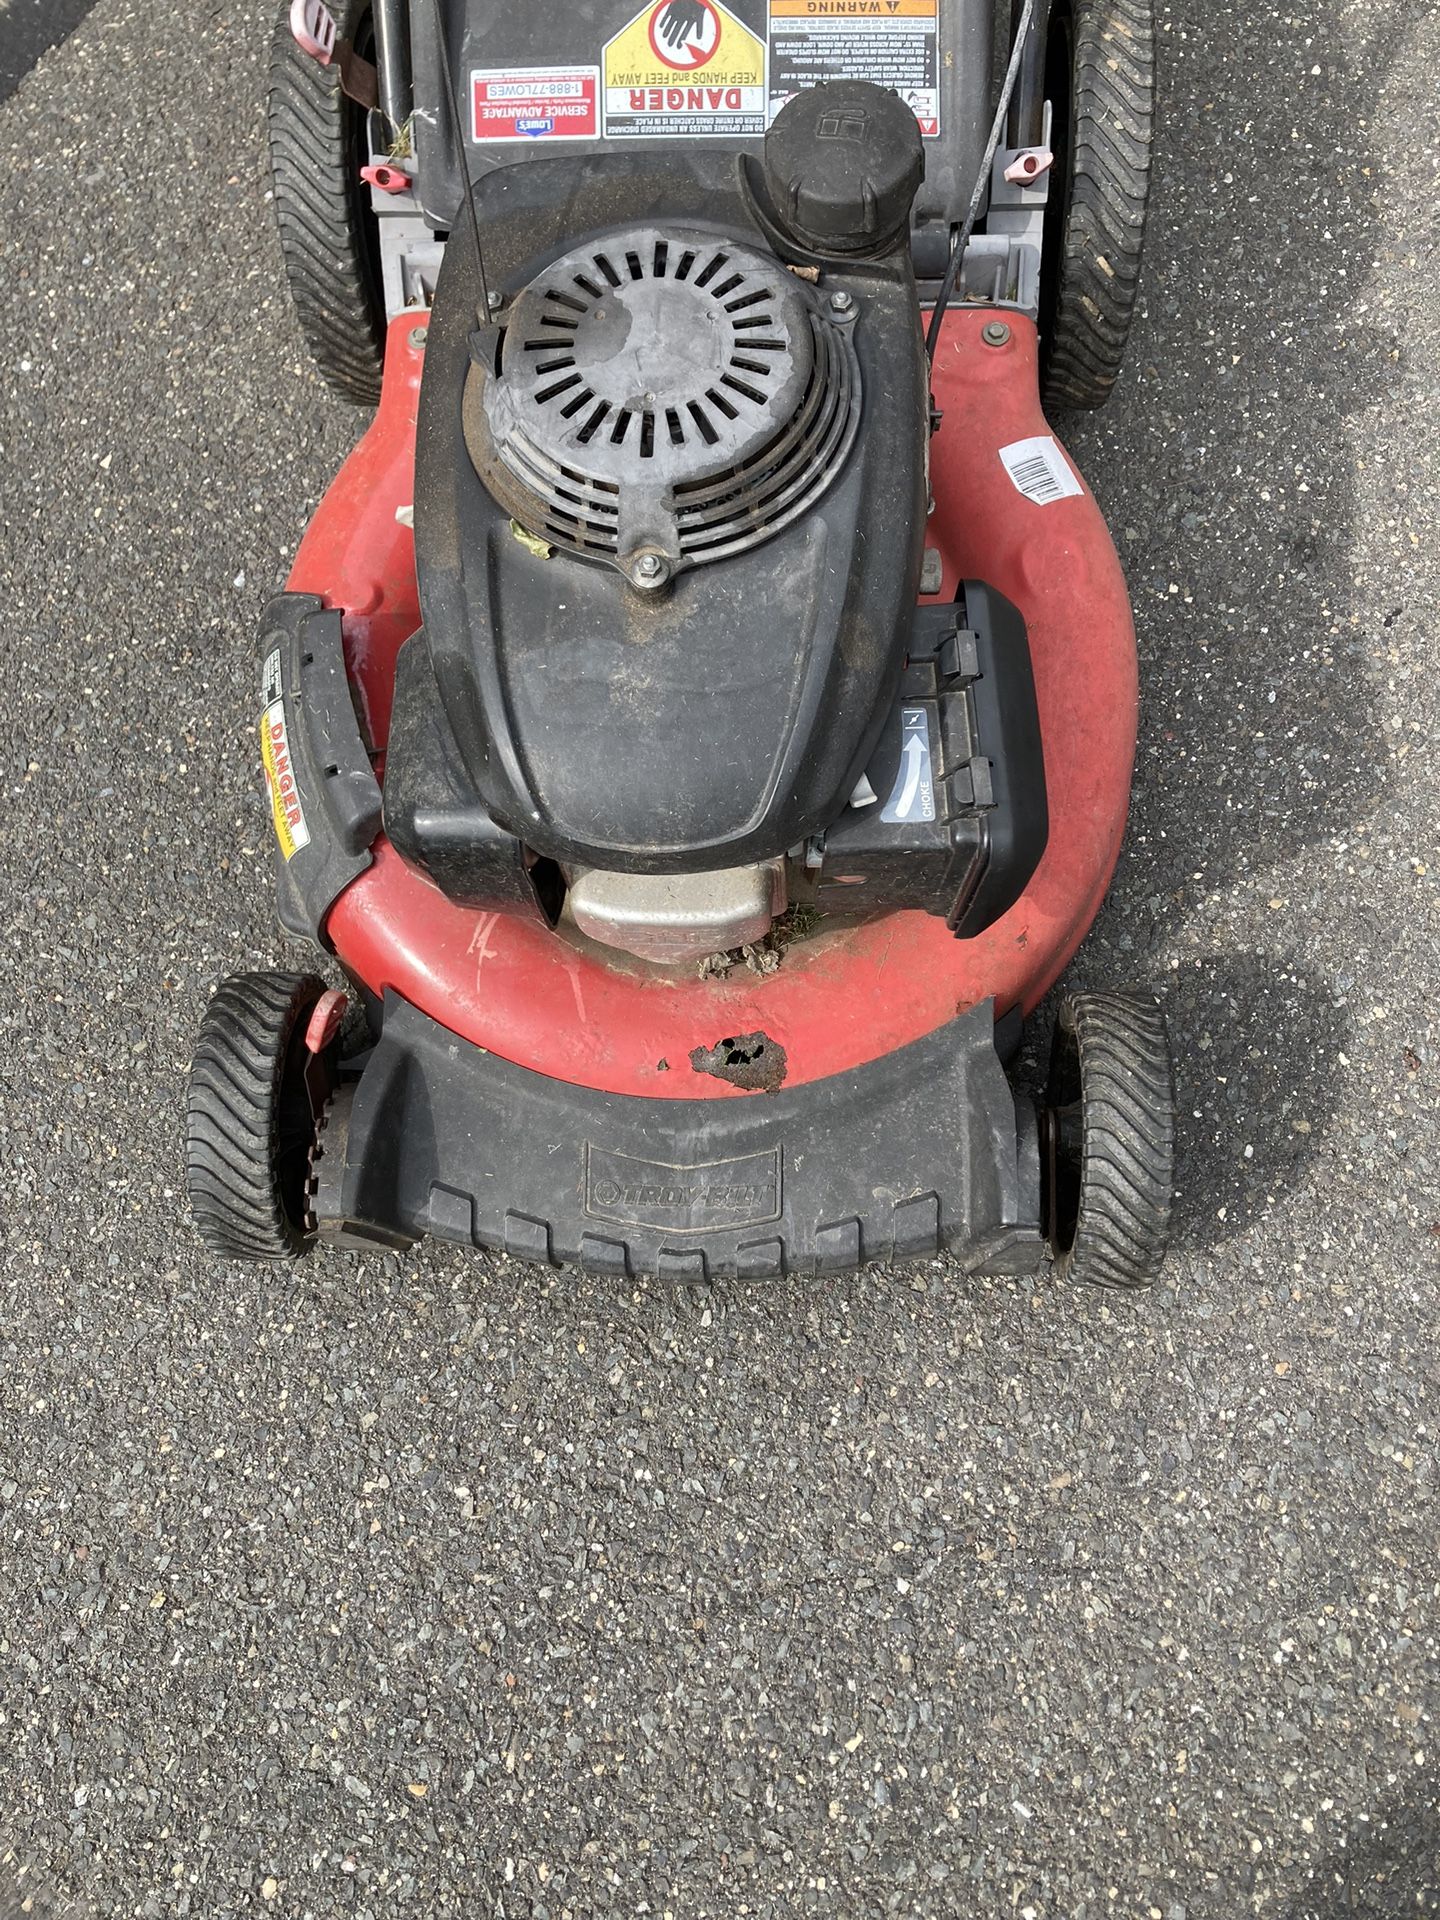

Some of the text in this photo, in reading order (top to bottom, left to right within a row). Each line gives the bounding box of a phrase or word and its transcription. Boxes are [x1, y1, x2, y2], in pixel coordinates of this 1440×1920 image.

[808, 2, 880, 12] WARNING
[611, 72, 756, 85] KEEP HANDS and FEET AWAY
[490, 84, 579, 96] 1-888-77LOWES
[629, 88, 741, 110] DANGER
[482, 105, 588, 118] SERVICE ADVANTAGE
[270, 723, 301, 828] DANGER
[920, 781, 932, 817] CHOKE
[274, 794, 286, 817] FEET
[282, 821, 294, 848] AWAY
[623, 1184, 770, 1208] TROY-BILT
